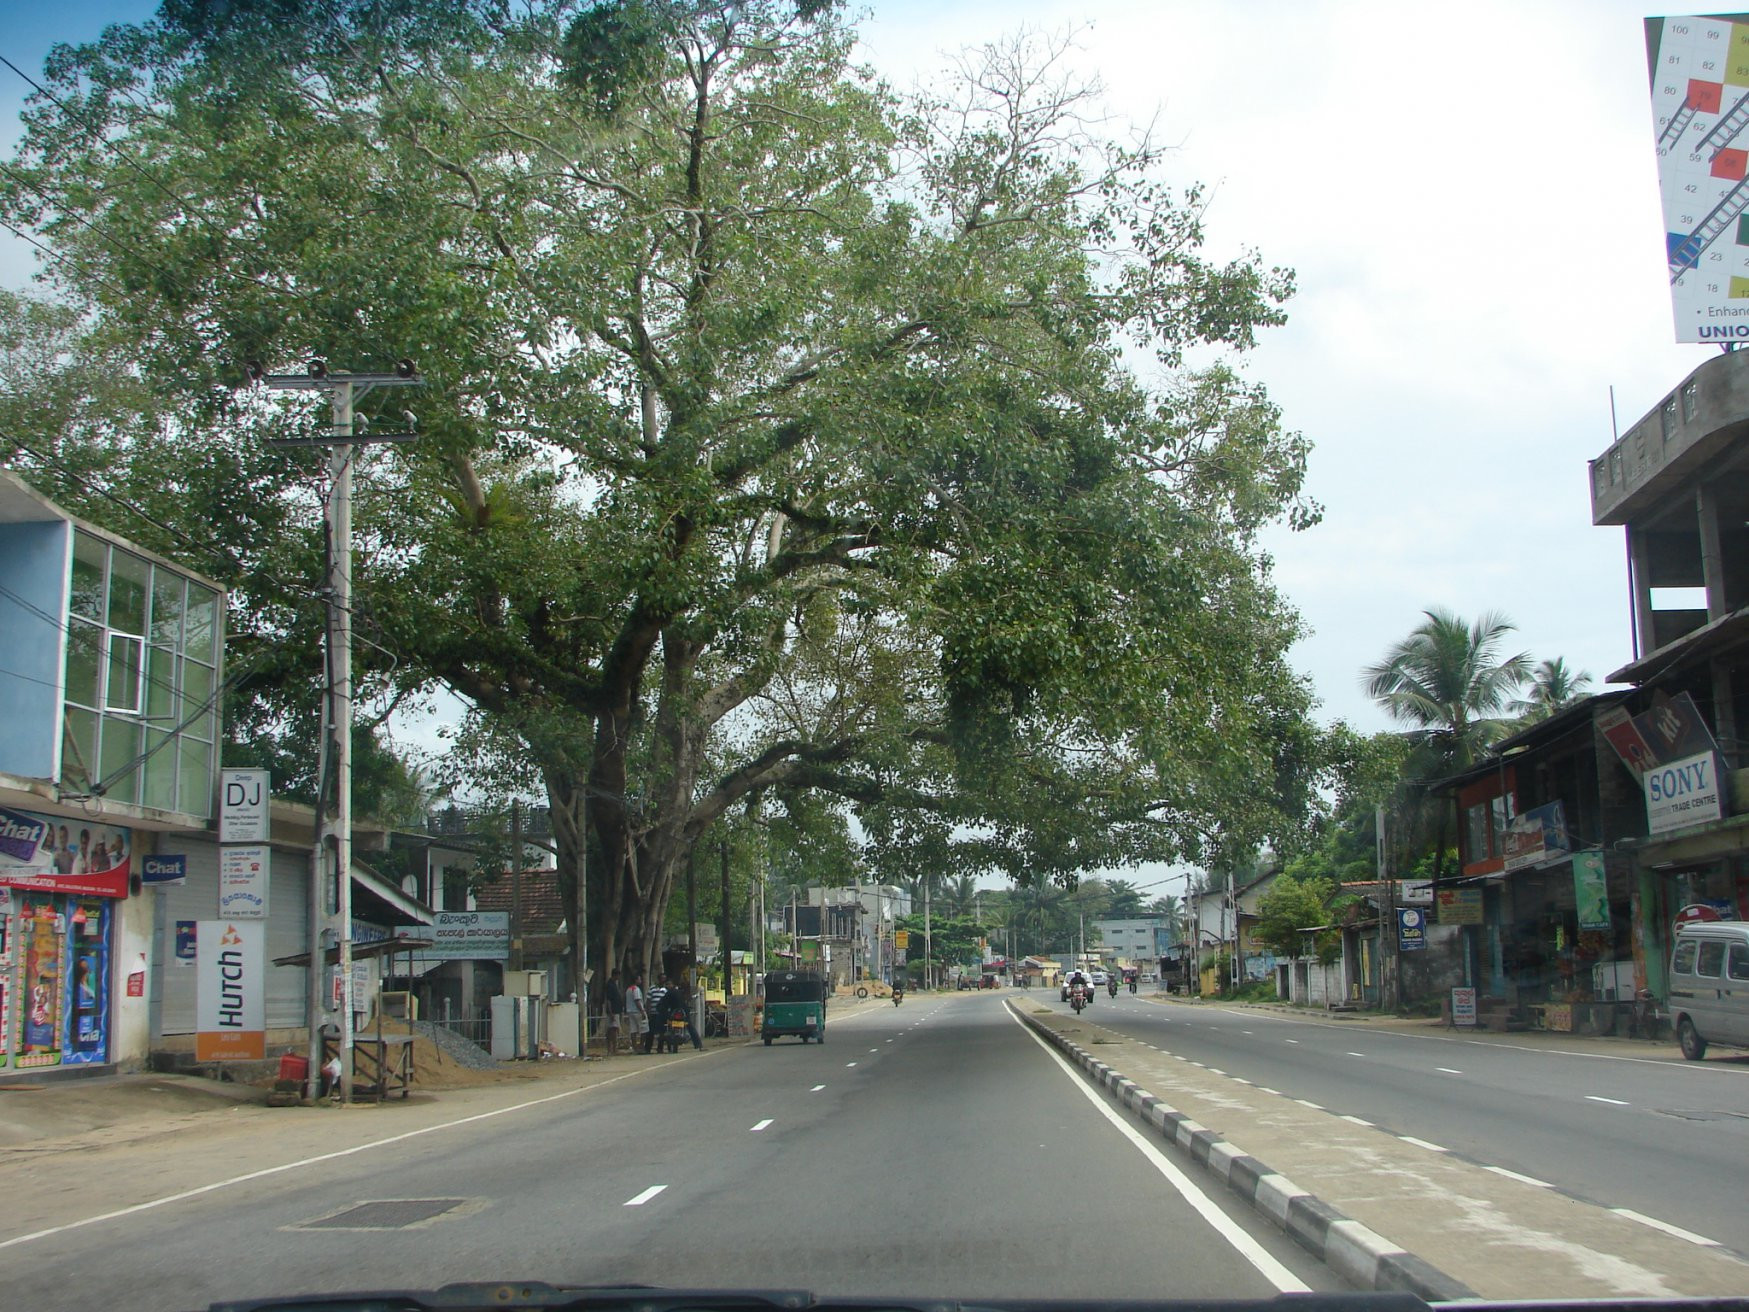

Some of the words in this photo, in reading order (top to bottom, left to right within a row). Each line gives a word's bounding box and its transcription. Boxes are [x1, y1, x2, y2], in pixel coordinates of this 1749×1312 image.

[1672, 25, 1688, 35] 100
[1707, 31, 1719, 40] 99
[1669, 55, 1680, 65] 81
[1702, 61, 1715, 71] 82
[1664, 86, 1676, 96] 80
[1693, 123, 1705, 132] 62
[1656, 147, 1667, 157] 60
[1689, 153, 1702, 162] 59
[1684, 184, 1697, 194] 42
[1681, 215, 1693, 224] 39
[1710, 252, 1722, 261] 23
[1707, 283, 1718, 293] 18
[1650, 760, 1707, 802] SONY
[227, 782, 260, 806] DJ
[1671, 801, 1691, 813] TRADE
[1691, 794, 1716, 809] CENTRE
[145, 861, 182, 874] Chat
[351, 920, 388, 943] NGINEERS
